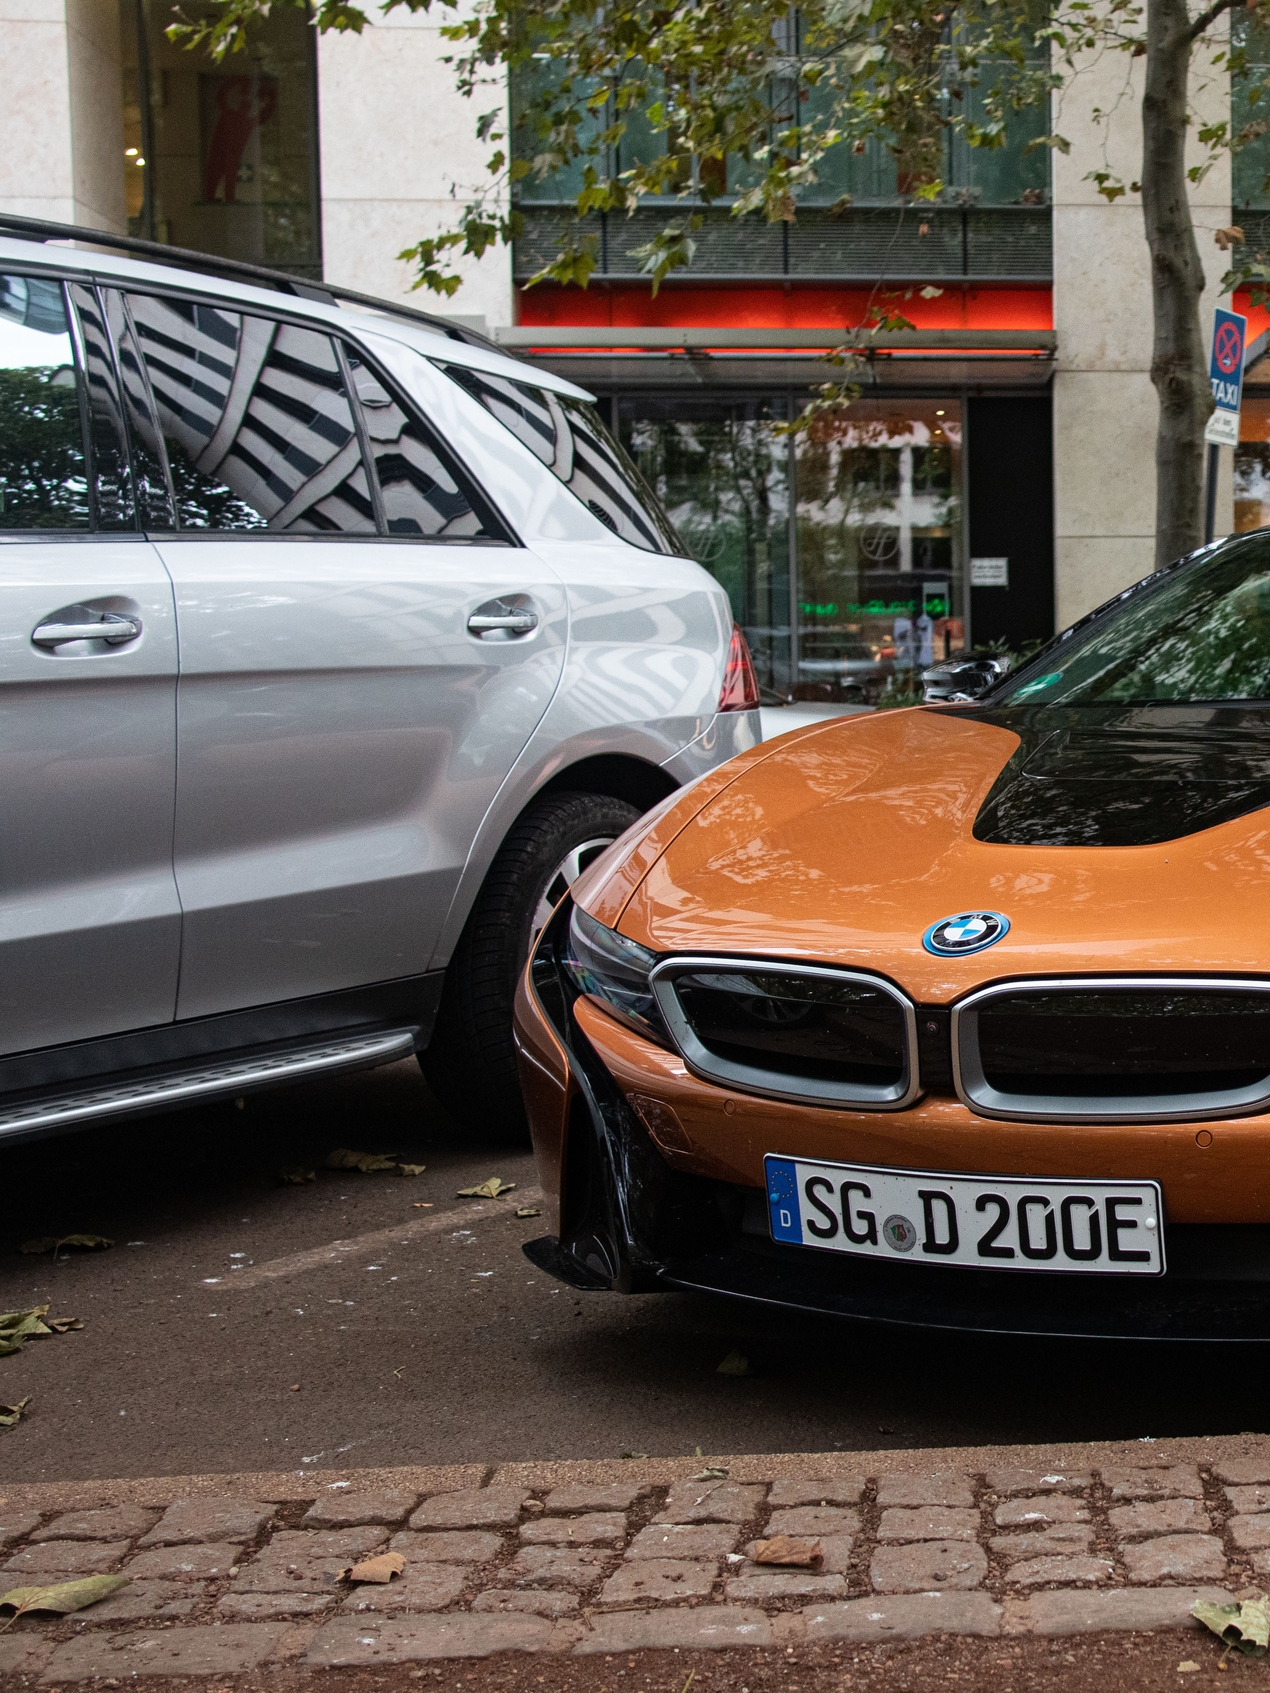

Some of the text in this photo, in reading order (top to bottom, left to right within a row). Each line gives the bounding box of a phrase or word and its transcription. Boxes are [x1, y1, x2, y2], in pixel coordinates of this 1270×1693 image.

[1211, 378, 1239, 405] TAXI
[780, 1209, 792, 1228] D
[804, 1175, 879, 1247] SG
[918, 1189, 960, 1255] D
[974, 1193, 1152, 1263] 200E
